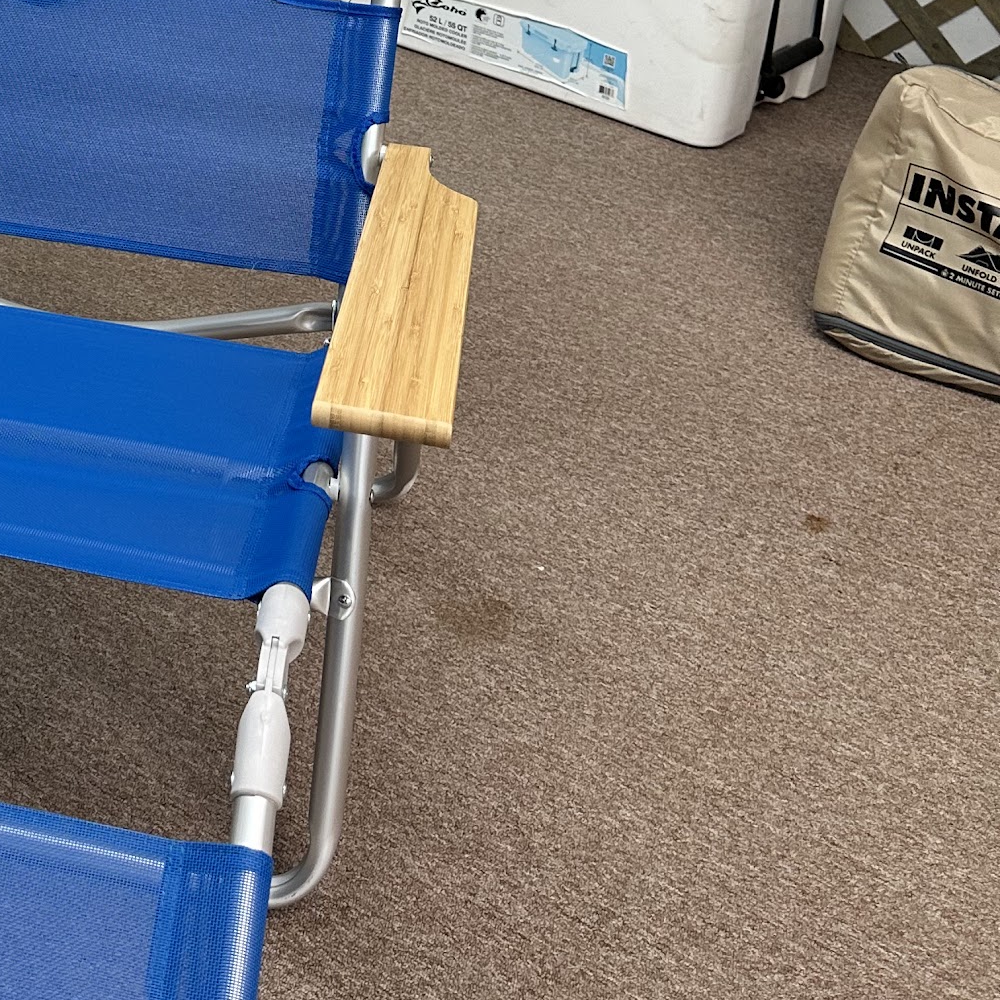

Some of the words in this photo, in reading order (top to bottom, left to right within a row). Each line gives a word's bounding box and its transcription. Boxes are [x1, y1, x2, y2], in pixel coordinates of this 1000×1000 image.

[457, 24, 468, 33] QT
[908, 172, 1000, 240] INST
[900, 240, 937, 260] UNPACK
[961, 263, 998, 283] UNFOLD
[948, 271, 956, 280] 2
[955, 274, 986, 292] MINUTE
[986, 286, 1000, 299] SET
